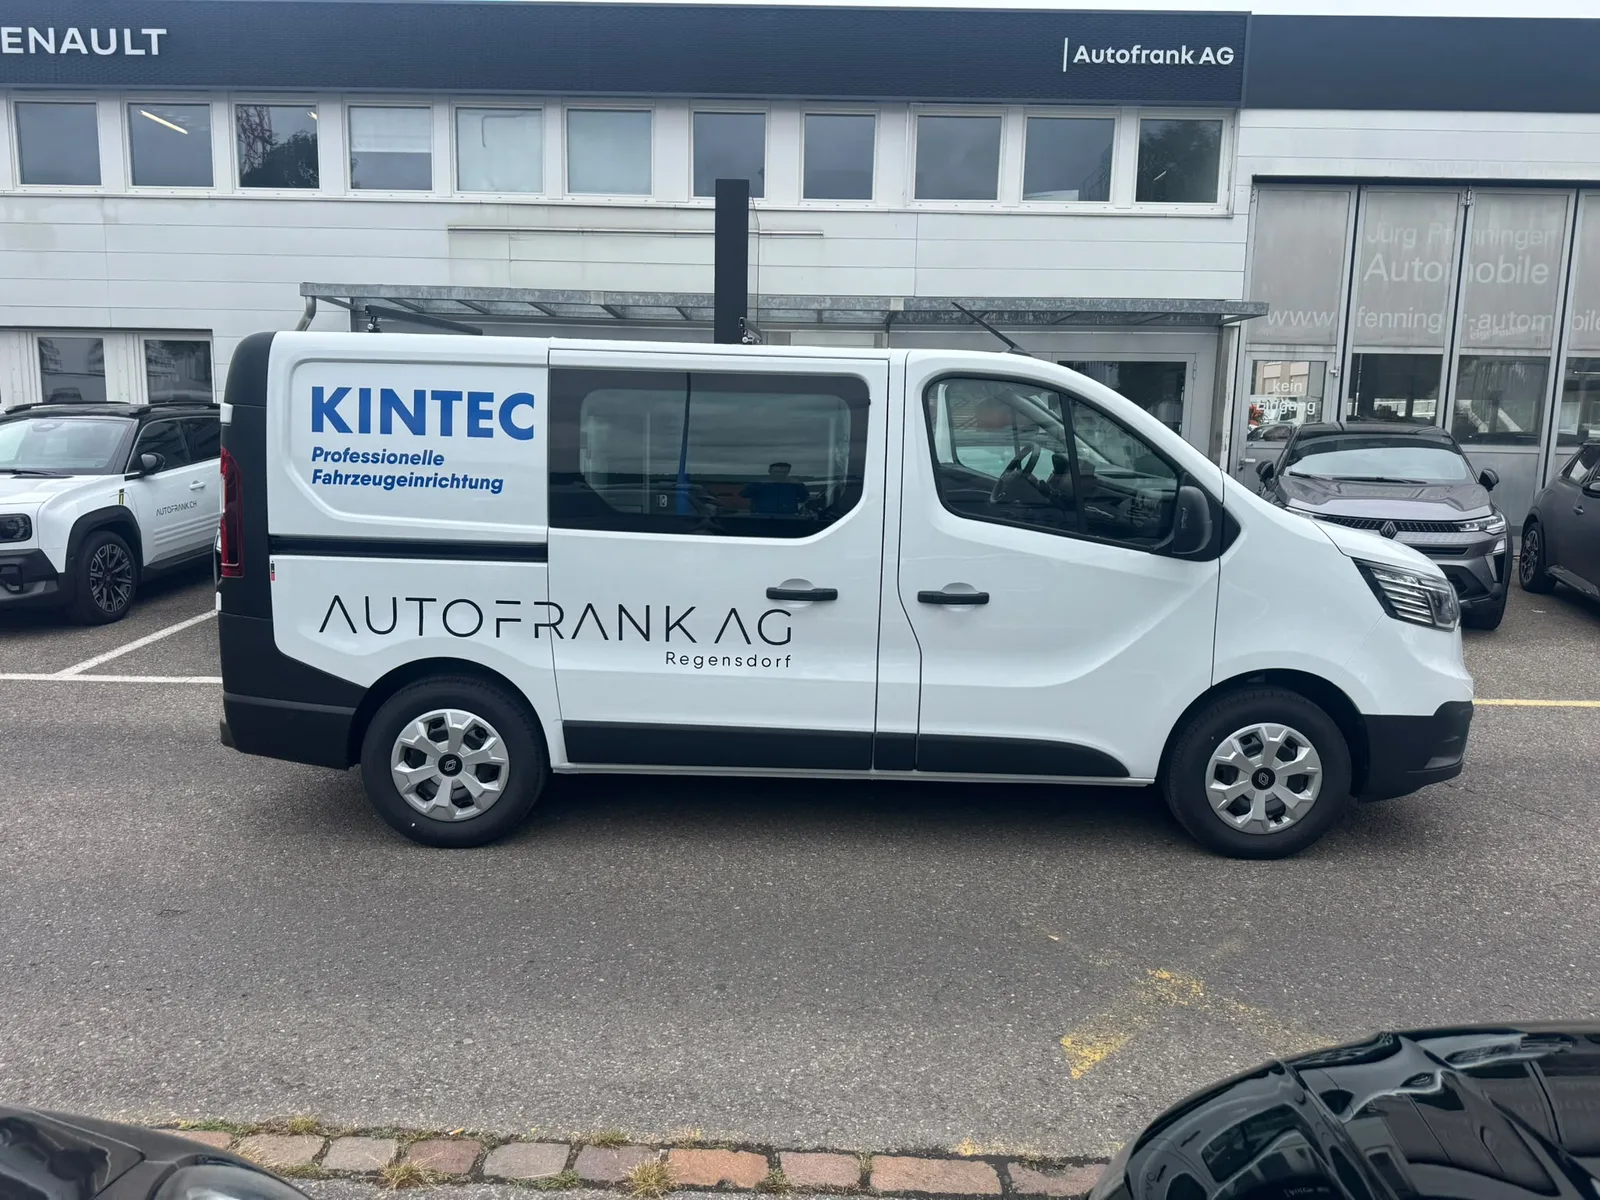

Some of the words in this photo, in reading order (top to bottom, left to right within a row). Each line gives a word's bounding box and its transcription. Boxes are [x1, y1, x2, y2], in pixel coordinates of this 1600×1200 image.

[1073, 44, 1195, 65] Autofrank
[1198, 46, 1235, 66] AG
[1427, 222, 1558, 251] Pfnninger
[1272, 378, 1303, 393] kein
[311, 385, 535, 441] KINTEC
[311, 446, 445, 467] Professionelle
[311, 468, 504, 495] Fahrzeugeinrichtung
[318, 594, 698, 645] AUTOFRANK
[713, 606, 793, 647] AG
[665, 651, 793, 669] Regensdorf
